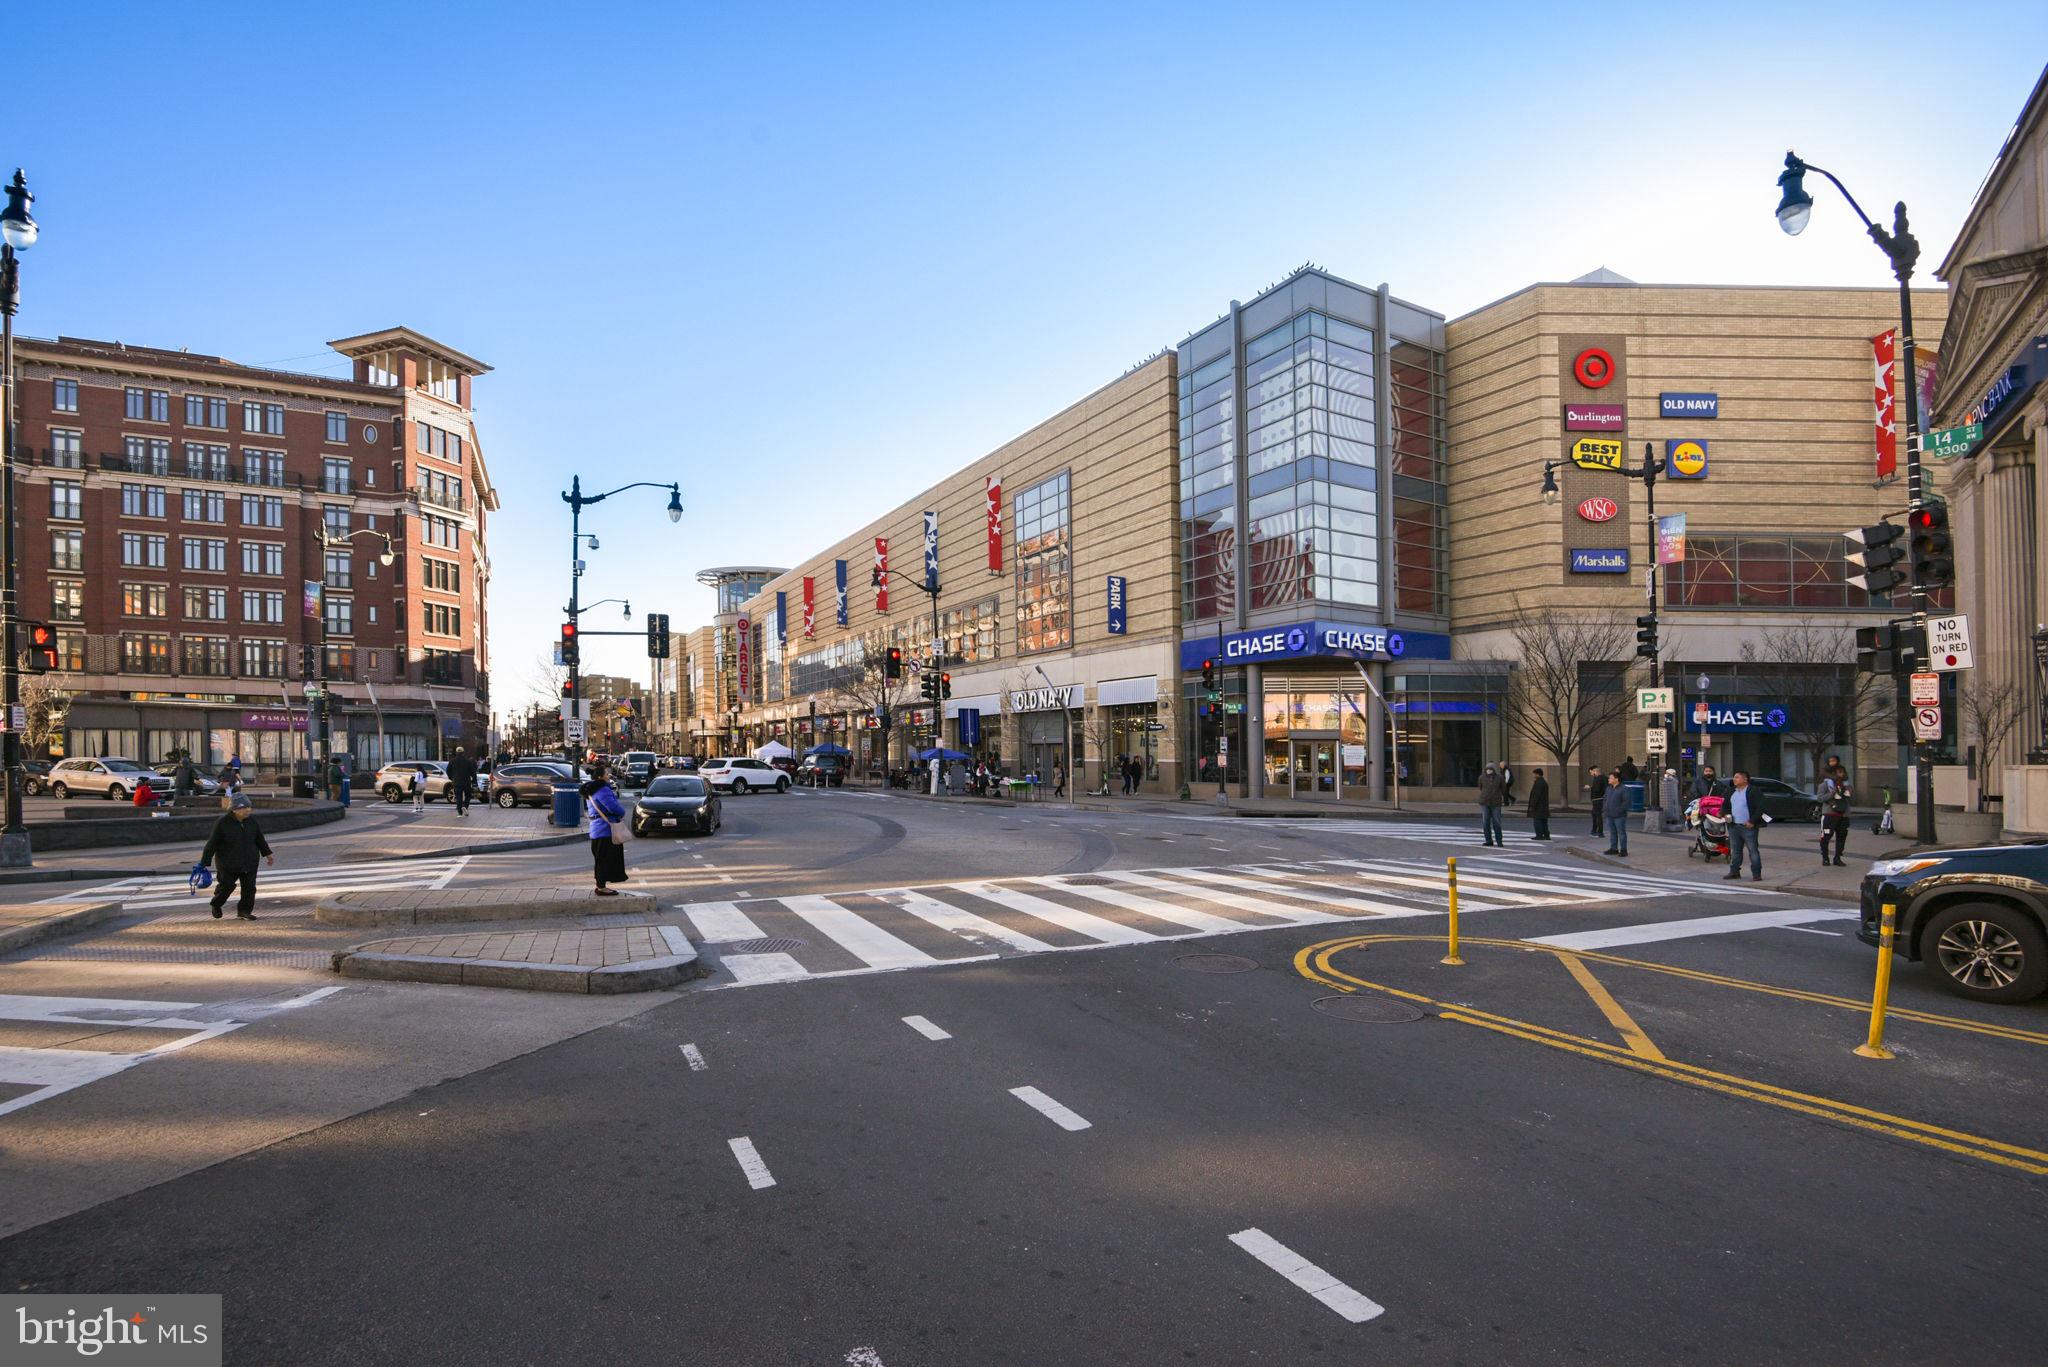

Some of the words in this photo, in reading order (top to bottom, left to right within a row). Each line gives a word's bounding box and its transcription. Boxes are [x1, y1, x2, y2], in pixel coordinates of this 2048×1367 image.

[1971, 396, 1988, 424] PNC
[1989, 369, 2012, 411] BANK
[1664, 400, 1685, 409] OLD
[1687, 400, 1716, 409] NAVY
[1568, 411, 1621, 424] Burlington
[1934, 432, 1951, 446] 14
[1580, 443, 1619, 454] BEST
[1936, 442, 1968, 456] 3300
[1581, 454, 1615, 465] BUY
[1584, 499, 1612, 519] WSC
[1574, 555, 1626, 567] Marshalls
[1110, 577, 1121, 610] PARK
[1938, 620, 1956, 631] NO
[1325, 630, 1386, 652] CHASE
[1936, 632, 1961, 642] TURN
[1227, 633, 1285, 657] CHASE
[1932, 645, 1945, 654] ON
[1949, 643, 1968, 652] RED
[739, 631, 748, 694] TARGET
[1017, 692, 1038, 711] OLD
[1040, 688, 1073, 708] NAVY
